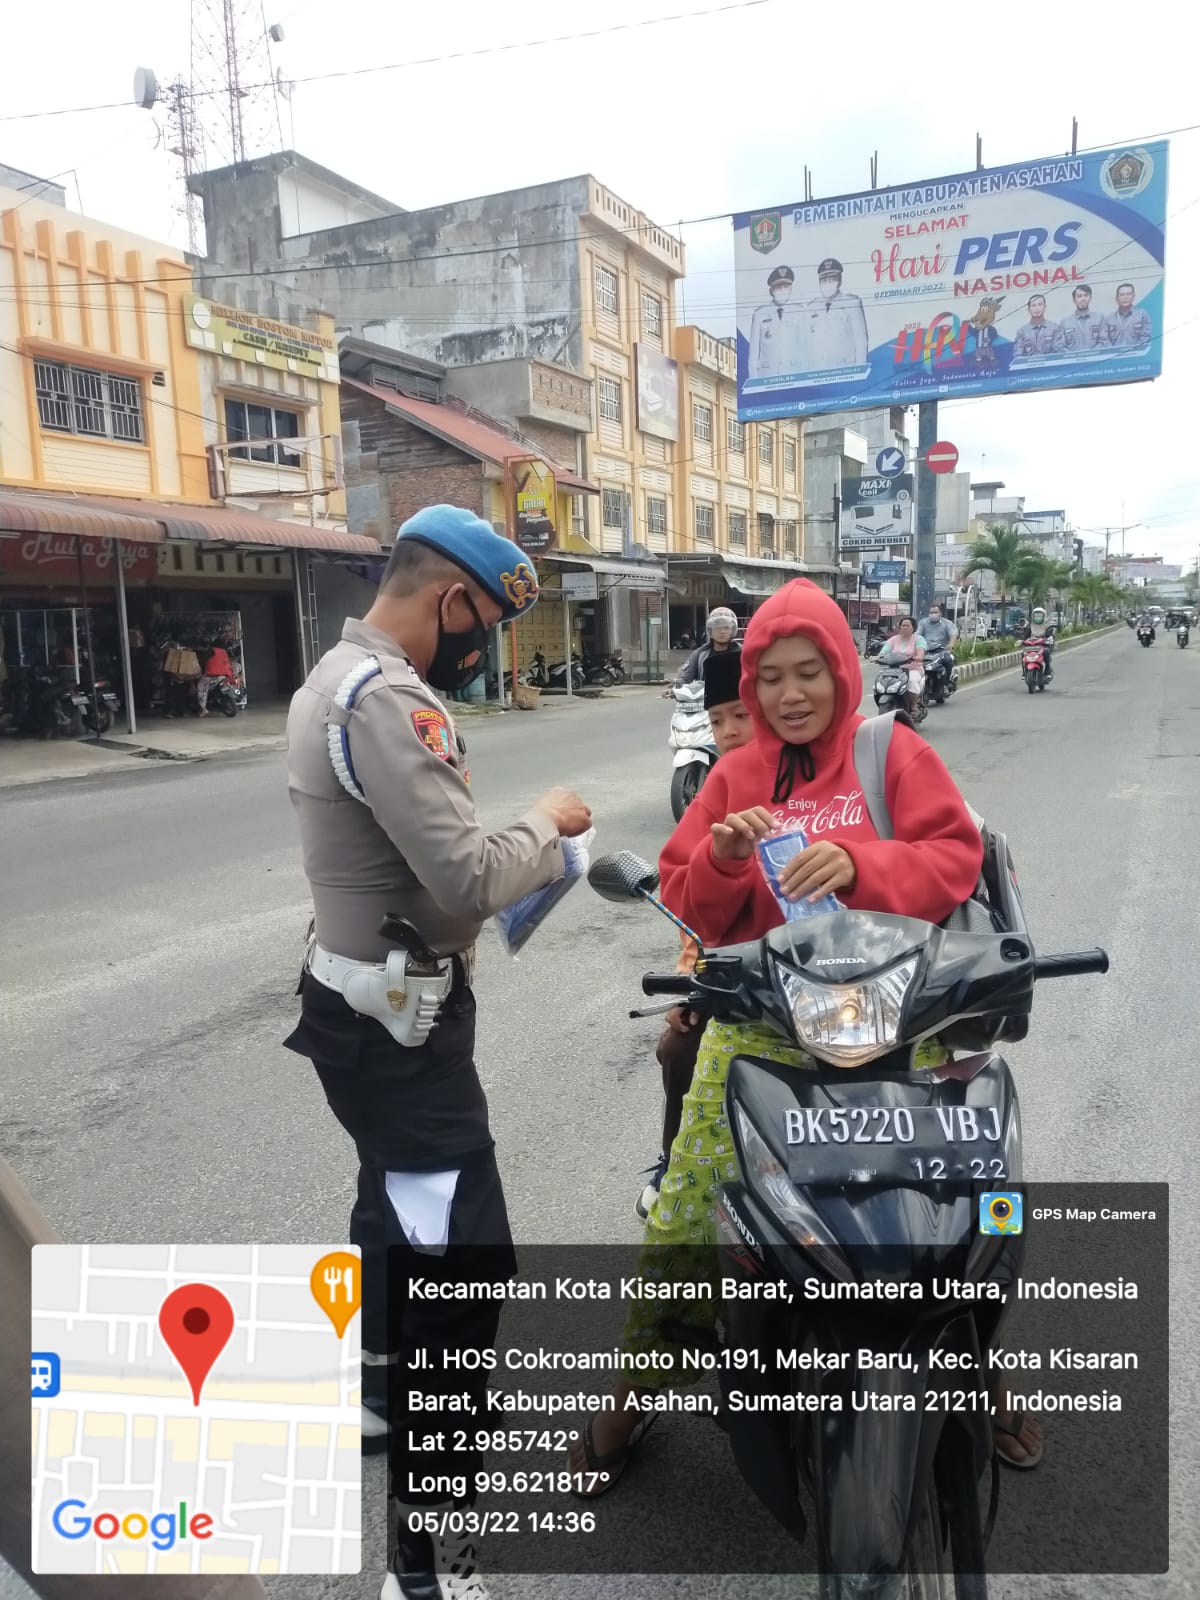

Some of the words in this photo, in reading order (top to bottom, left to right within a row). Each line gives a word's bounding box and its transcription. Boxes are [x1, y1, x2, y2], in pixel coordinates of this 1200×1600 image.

[793, 195, 898, 225] PEMERINTAH
[900, 175, 1003, 207] KABUPATEN
[1005, 160, 1083, 190] ASAHAN
[889, 202, 964, 221] MENGUCAPKAN
[884, 214, 969, 239] SELAMAT
[870, 242, 948, 283] Hari
[953, 221, 1083, 276] PERS
[953, 264, 1086, 297] NASIONAL
[842, 538, 873, 546] COKRO
[788, 797, 818, 812] Enjoy
[815, 957, 867, 966] HONDA
[936, 1106, 1002, 1143] VBJ
[969, 1158, 1007, 1180] 22
[722, 1191, 765, 1263] HONDA
